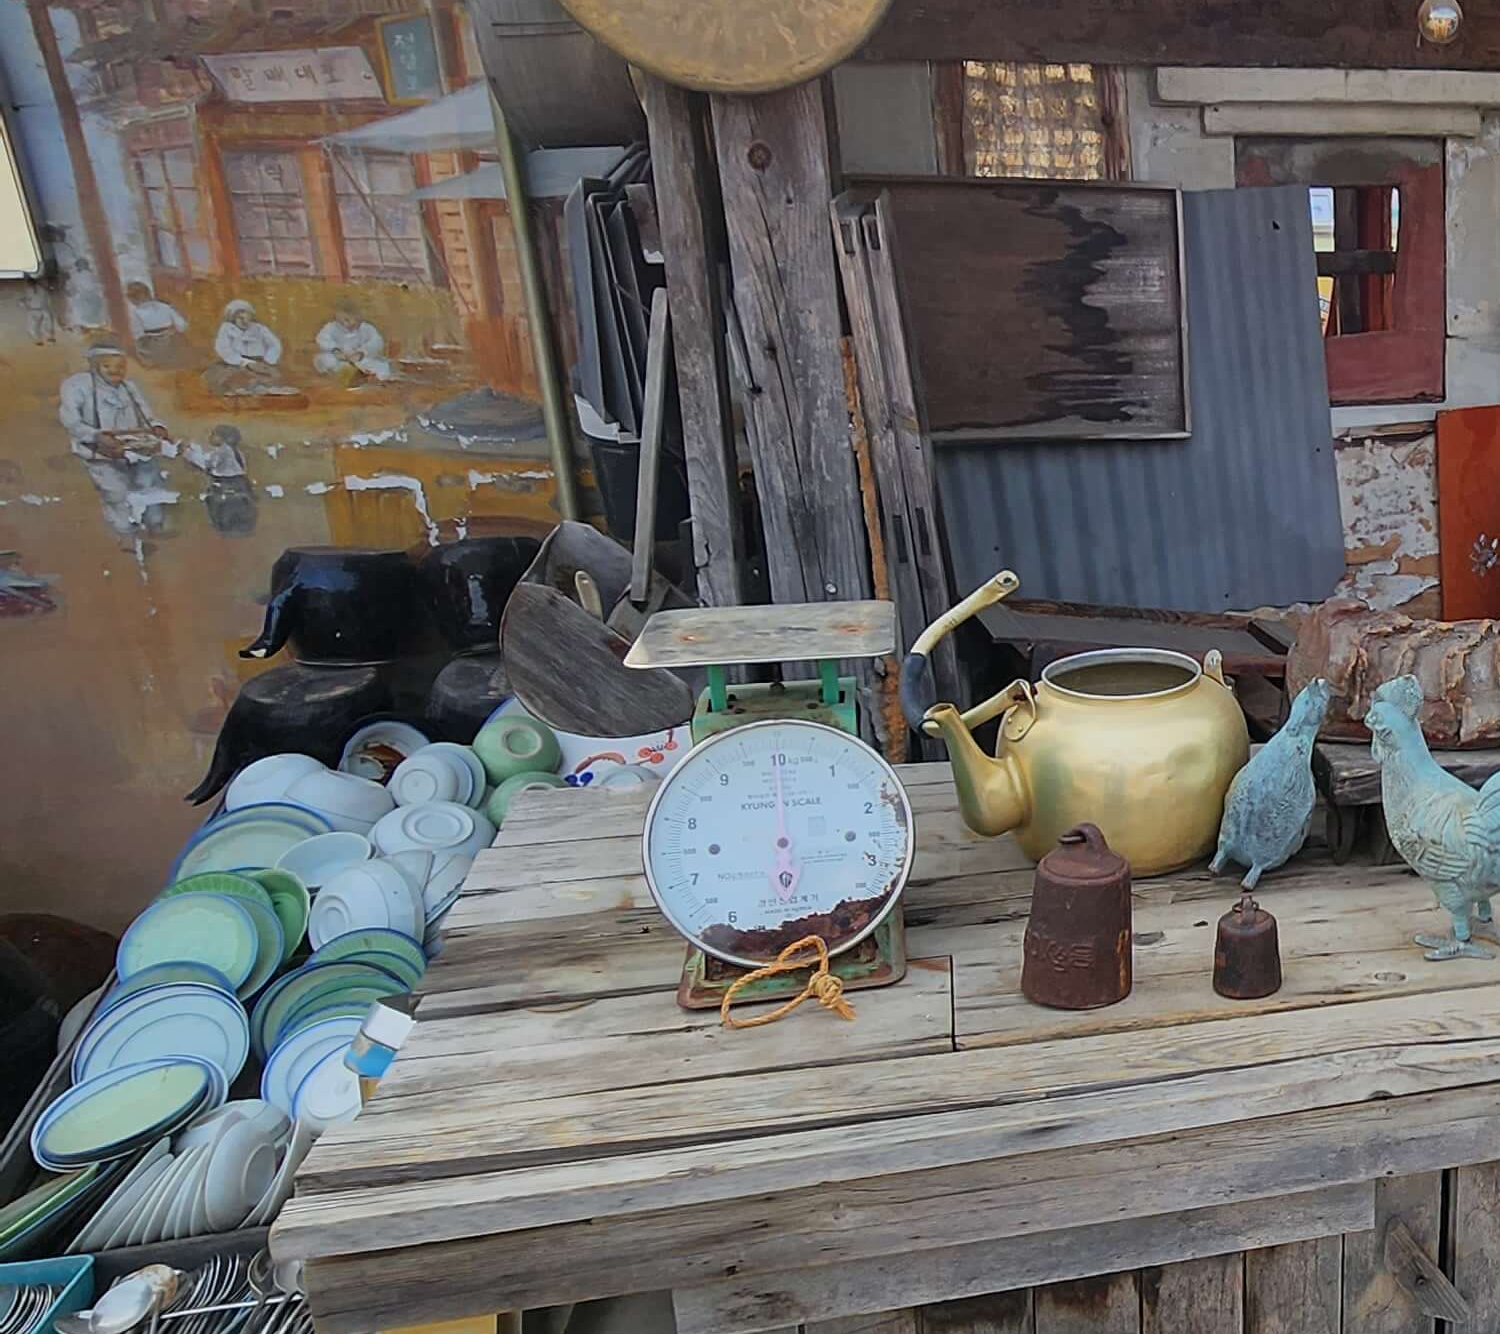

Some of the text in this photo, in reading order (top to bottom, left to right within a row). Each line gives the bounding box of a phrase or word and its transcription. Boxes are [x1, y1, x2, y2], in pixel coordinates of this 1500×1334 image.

[719, 773, 729, 786] 9
[863, 802, 873, 815] 2
[687, 817, 697, 830] 8
[688, 872, 699, 886] 7
[727, 910, 738, 923] 6
